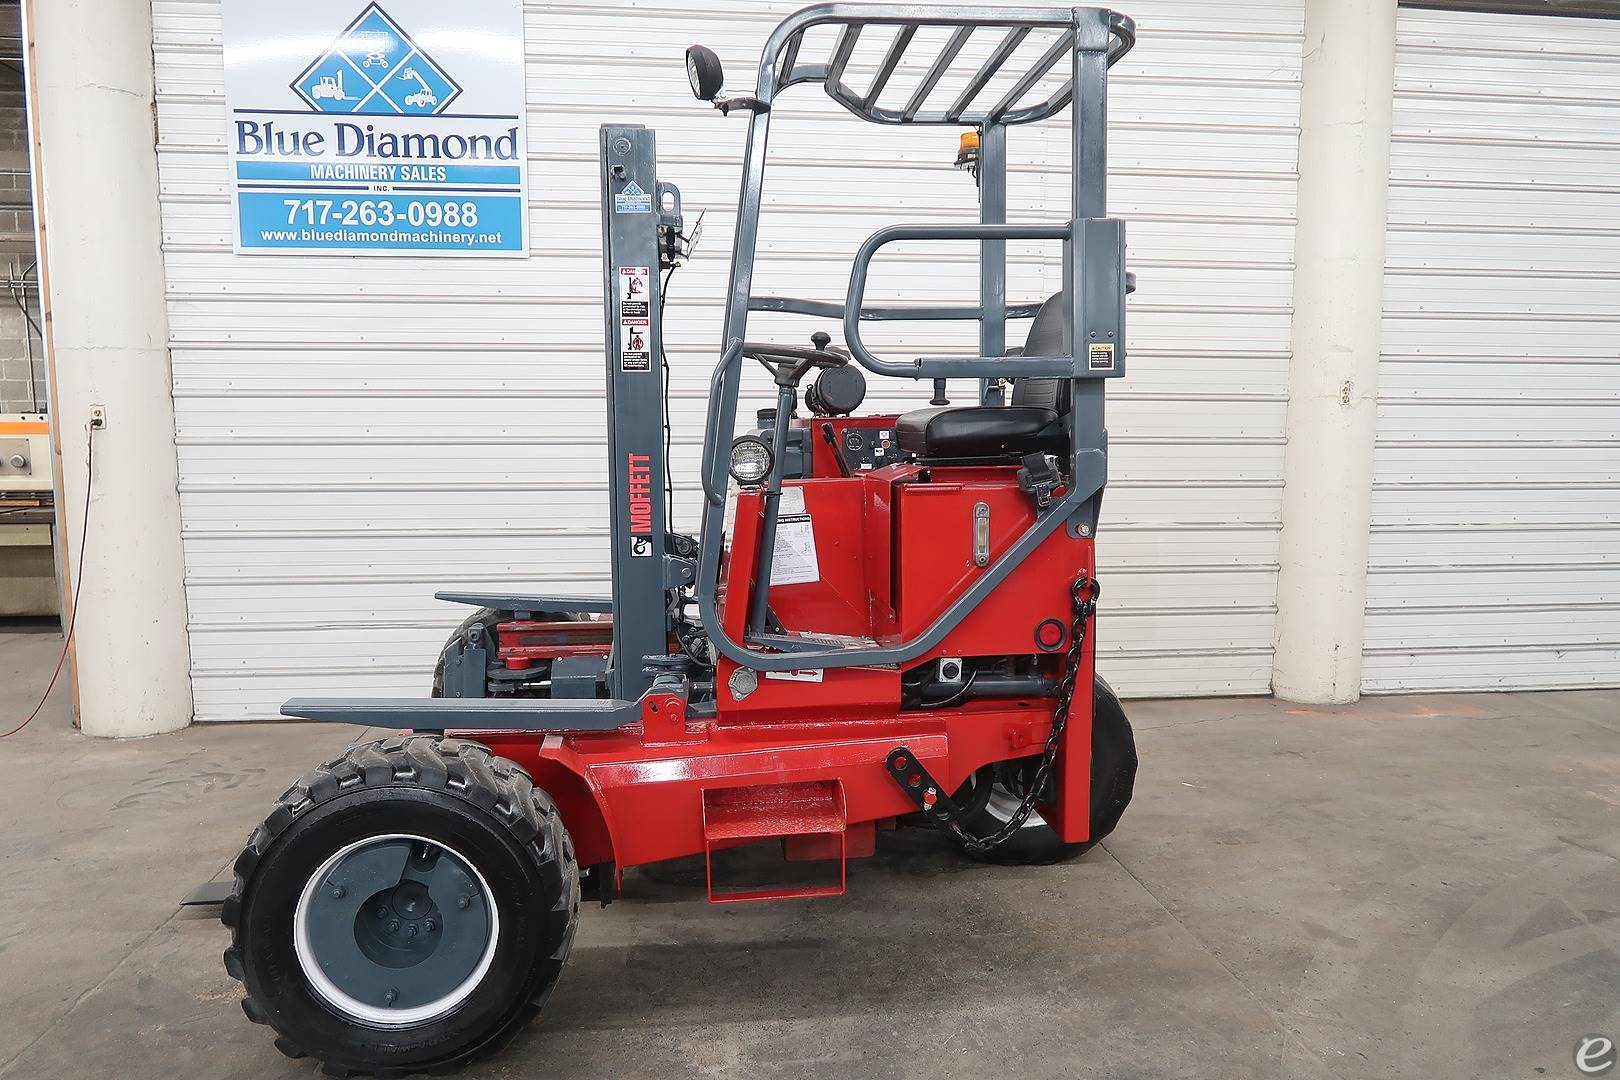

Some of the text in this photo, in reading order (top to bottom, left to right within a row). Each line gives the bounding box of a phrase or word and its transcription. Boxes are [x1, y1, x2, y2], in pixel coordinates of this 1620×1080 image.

[235, 120, 519, 161] Blue Diamond
[310, 164, 446, 181] MACHINERY SALES
[283, 199, 478, 227] 717-263-0988
[260, 229, 502, 244] www.bluediamondmachinery.net
[628, 453, 652, 533] MOFFETT
